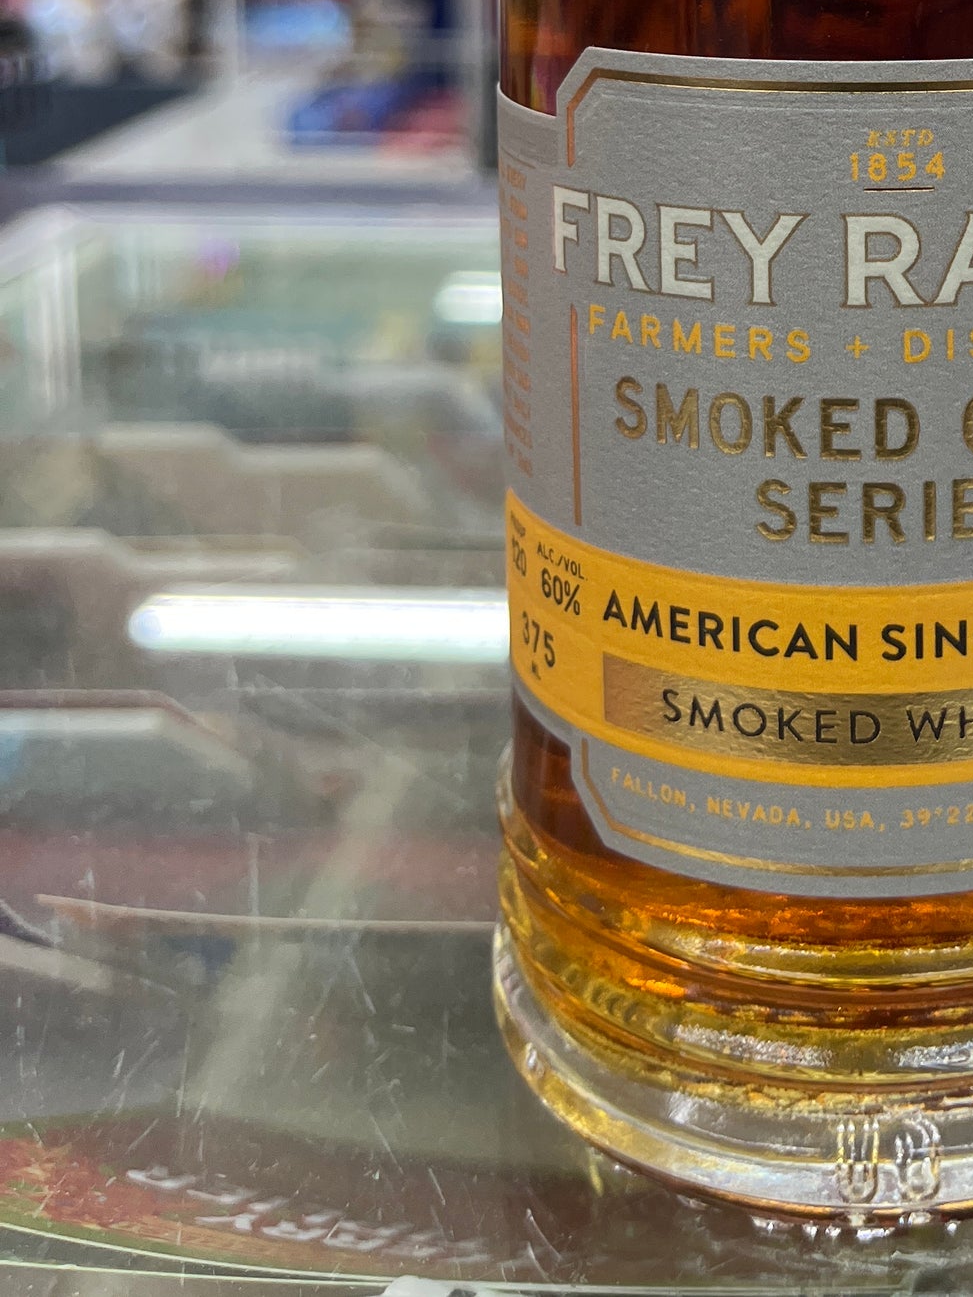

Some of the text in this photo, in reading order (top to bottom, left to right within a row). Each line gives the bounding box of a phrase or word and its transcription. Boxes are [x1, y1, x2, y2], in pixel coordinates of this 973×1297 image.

[849, 151, 946, 182] 1854
[551, 183, 808, 308] FREY
[588, 304, 813, 364] FARMERS
[614, 375, 921, 462] SMOKED
[541, 567, 582, 616] 60%
[521, 610, 556, 669] 375
[602, 589, 860, 663] AMERICAN
[661, 687, 883, 745] SMOKED
[610, 766, 696, 814] FALLON,
[706, 796, 812, 831] NEVADA,
[824, 807, 886, 833] USA,
